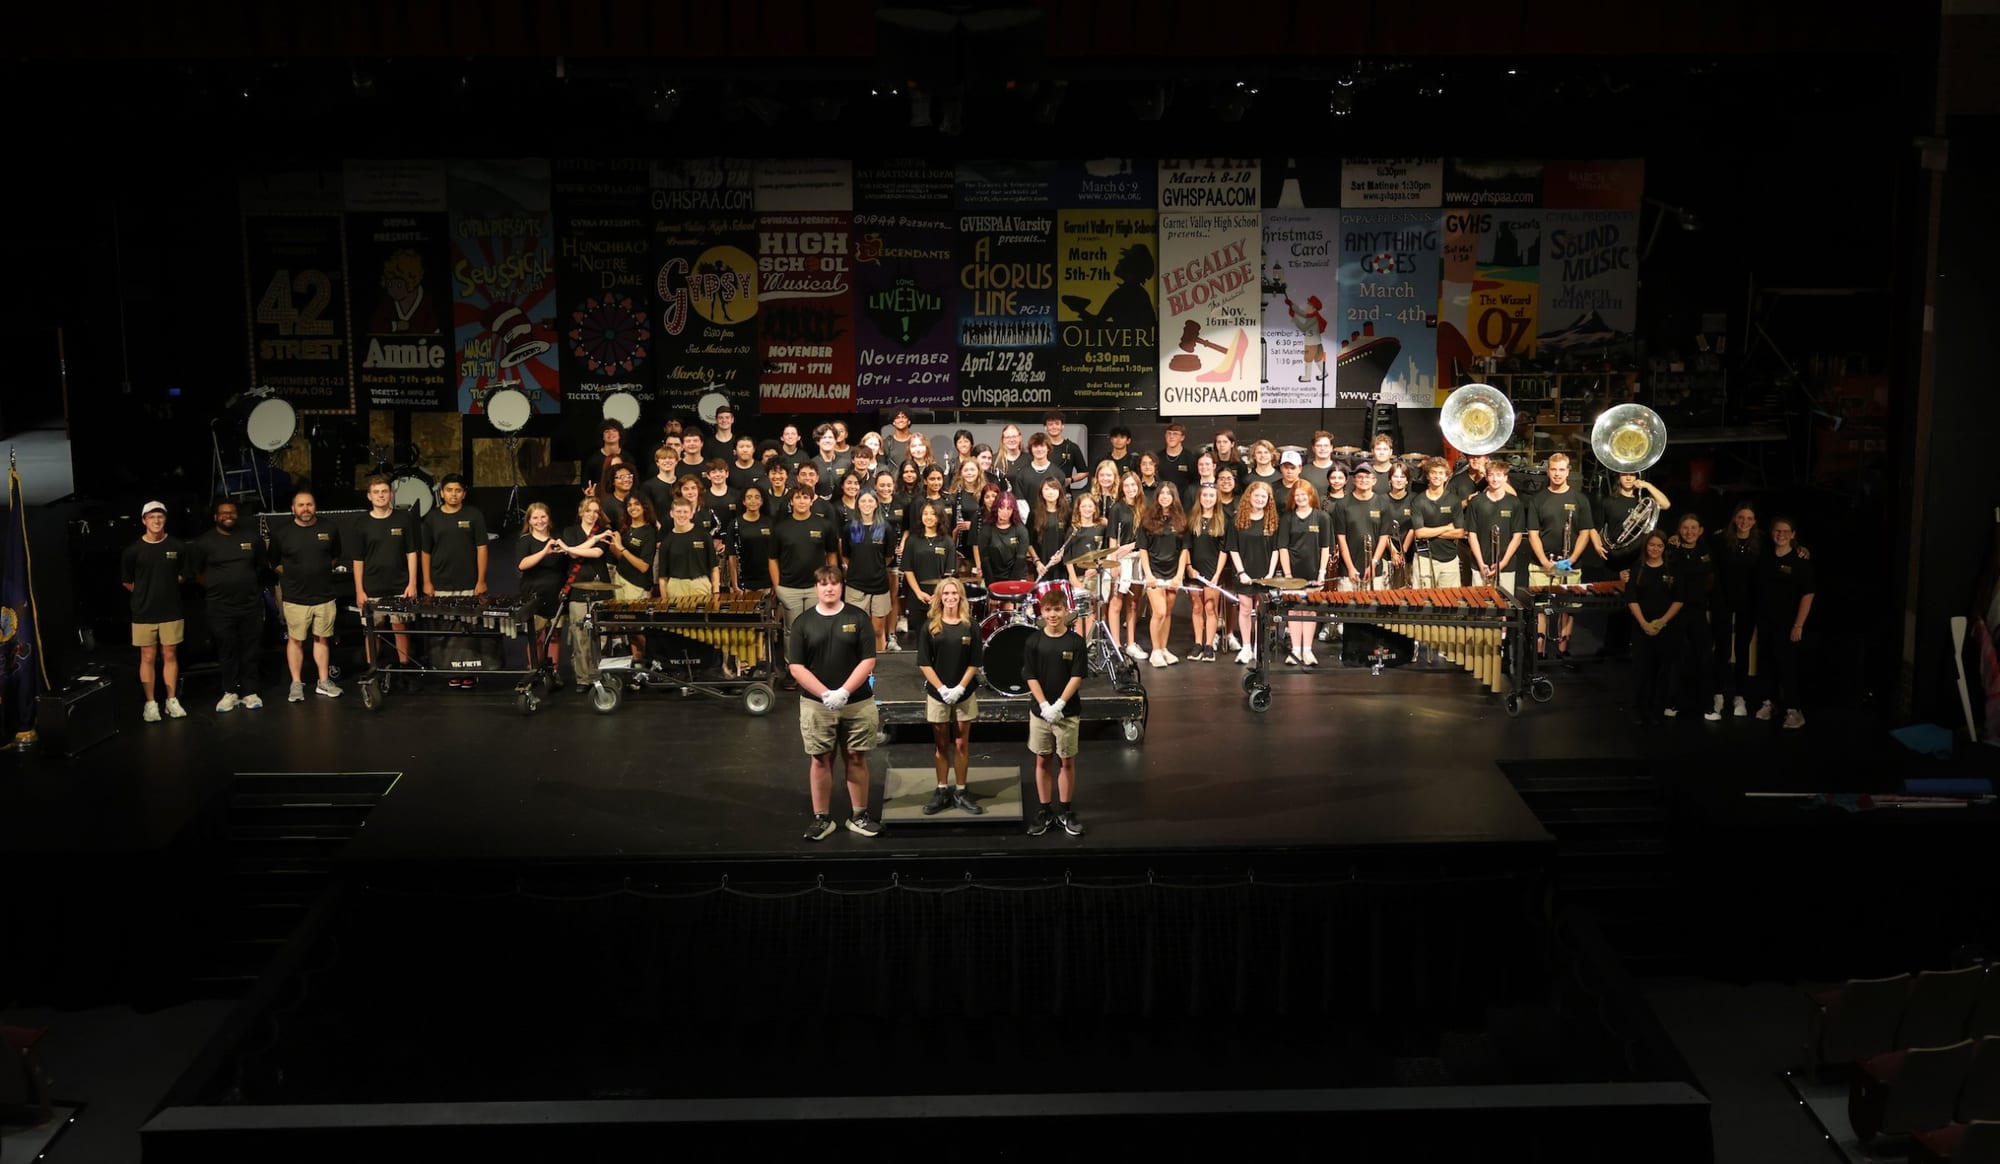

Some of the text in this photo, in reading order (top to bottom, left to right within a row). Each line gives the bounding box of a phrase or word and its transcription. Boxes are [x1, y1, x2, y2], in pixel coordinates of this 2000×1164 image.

[1170, 172, 1251, 183] March 8-10
[1082, 181, 1117, 192] March
[1351, 181, 1431, 192] Sat Matinee 1:30pm
[651, 190, 753, 210] GVHSPAA.COM
[1162, 188, 1256, 207] GVHSPAA.COM
[1446, 191, 1535, 206] www.gvhspaa.com
[959, 216, 1053, 235] GVHSPAA Varsity
[1162, 216, 1188, 229] Garnet
[1189, 216, 1212, 232] Valley
[1213, 216, 1232, 232] High
[1234, 215, 1259, 228] School
[1446, 214, 1493, 234] GVHS
[1262, 226, 1323, 243] hristmas
[1345, 230, 1437, 251] ANYTHING
[759, 232, 849, 255] HIGH
[974, 235, 992, 262] A
[1290, 240, 1332, 257] Carol
[1069, 248, 1107, 261] March
[1161, 237, 1248, 295] LEGALLY
[1562, 246, 1630, 282] MUSIC
[601, 271, 643, 288] DAME
[762, 272, 849, 291] Musical
[960, 262, 1054, 290] CHORUS
[1065, 267, 1110, 281] 5th-7th
[1166, 262, 1255, 317] BLONDE
[1359, 282, 1415, 298] March
[257, 268, 335, 336] 42
[974, 290, 1018, 317] LINE
[1480, 294, 1531, 305] The Wizard
[1019, 305, 1051, 314] PG-13
[1347, 305, 1380, 321] 2nd
[1396, 305, 1426, 323] 4th
[1515, 306, 1524, 317] of
[1062, 325, 1155, 348] OLIVER!
[259, 338, 343, 361] STREET
[362, 337, 446, 369] Annie
[768, 345, 833, 358] NOVEMBER
[860, 349, 950, 366] NOVEMBER
[960, 350, 1034, 378] April 27-28
[1084, 352, 1130, 366] 6:30pm
[667, 365, 703, 380] March
[807, 362, 833, 375] 17TH
[1061, 364, 1093, 374] Saturday
[362, 375, 396, 384] March
[857, 372, 891, 387] 18TH
[908, 371, 951, 385] 20TH
[568, 392, 600, 400] TICKETS
[961, 385, 1051, 408] gvhspaa.com
[1164, 387, 1259, 403] GVHSPAA.com
